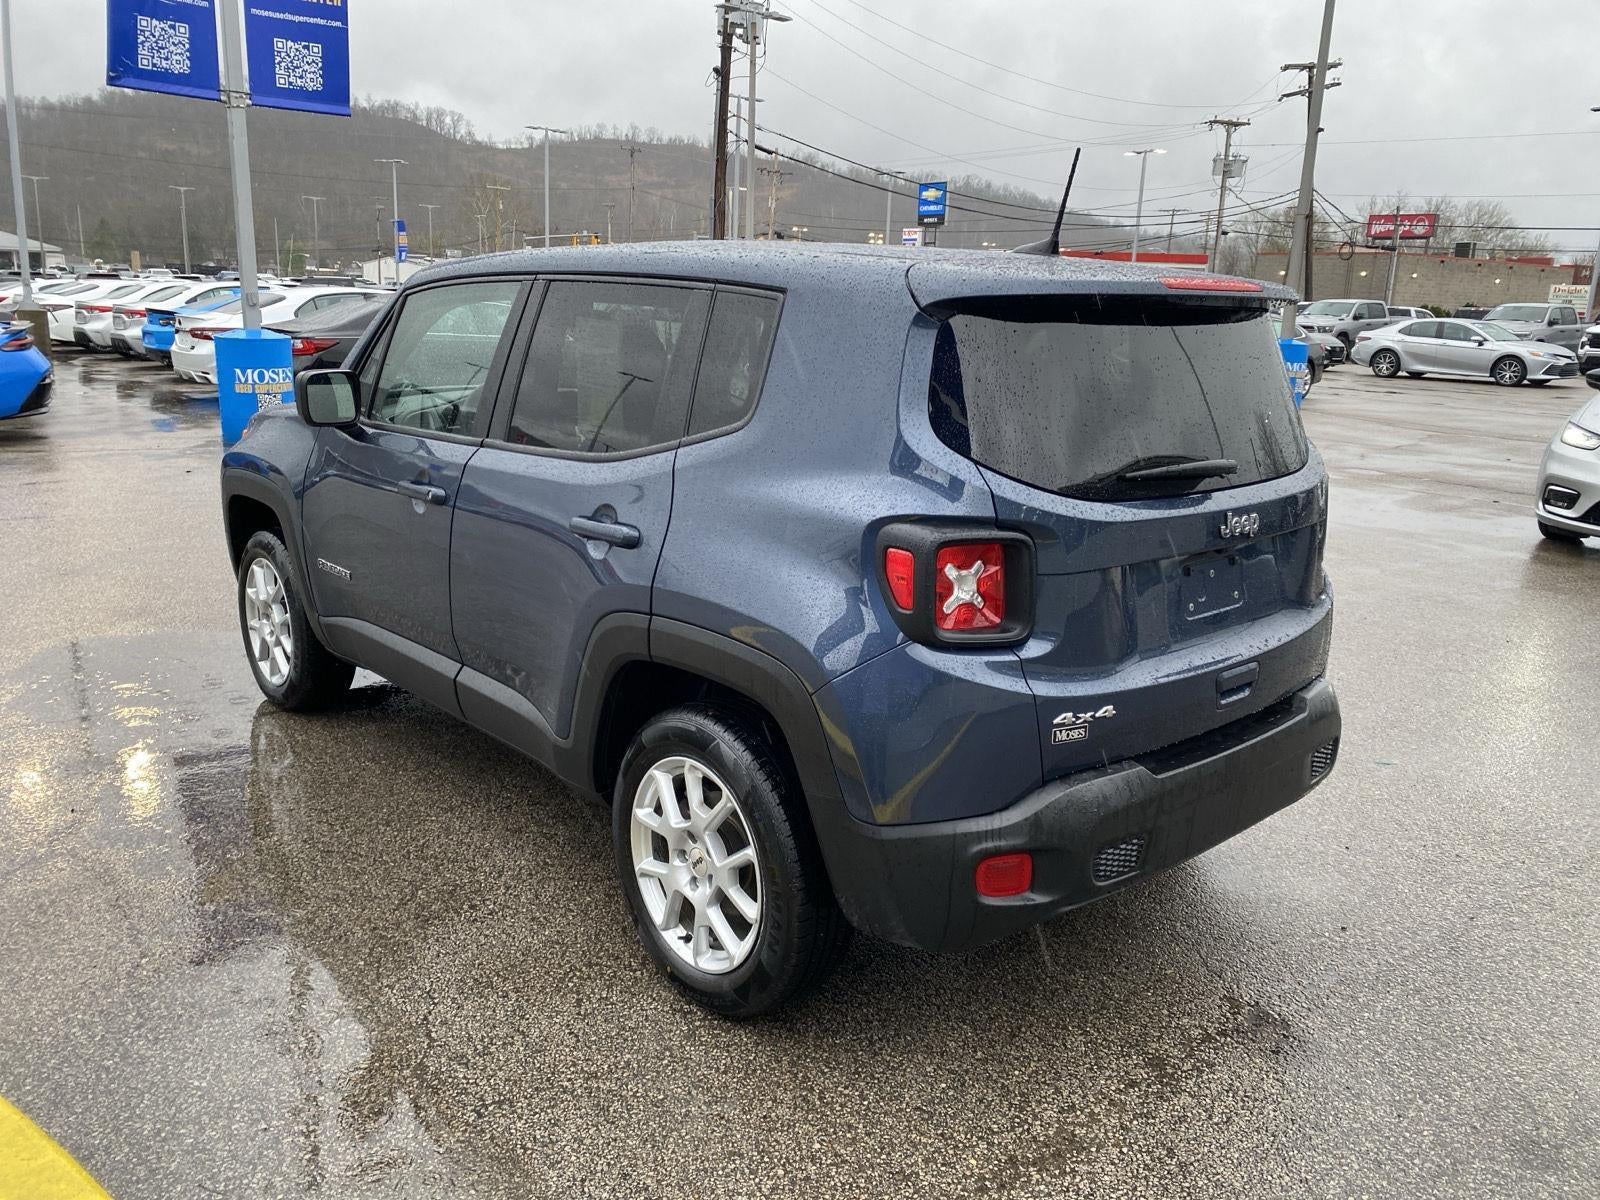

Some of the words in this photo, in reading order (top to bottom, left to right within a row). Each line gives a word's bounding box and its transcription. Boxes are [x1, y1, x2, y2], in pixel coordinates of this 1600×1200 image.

[250, 7, 343, 28] mosesusedsupercenter.com
[1370, 217, 1411, 235] Weny's
[234, 367, 293, 384] MOSES
[1220, 511, 1260, 538] Jeep
[1052, 704, 1117, 725] 4x4
[1055, 727, 1086, 742] MOSES
